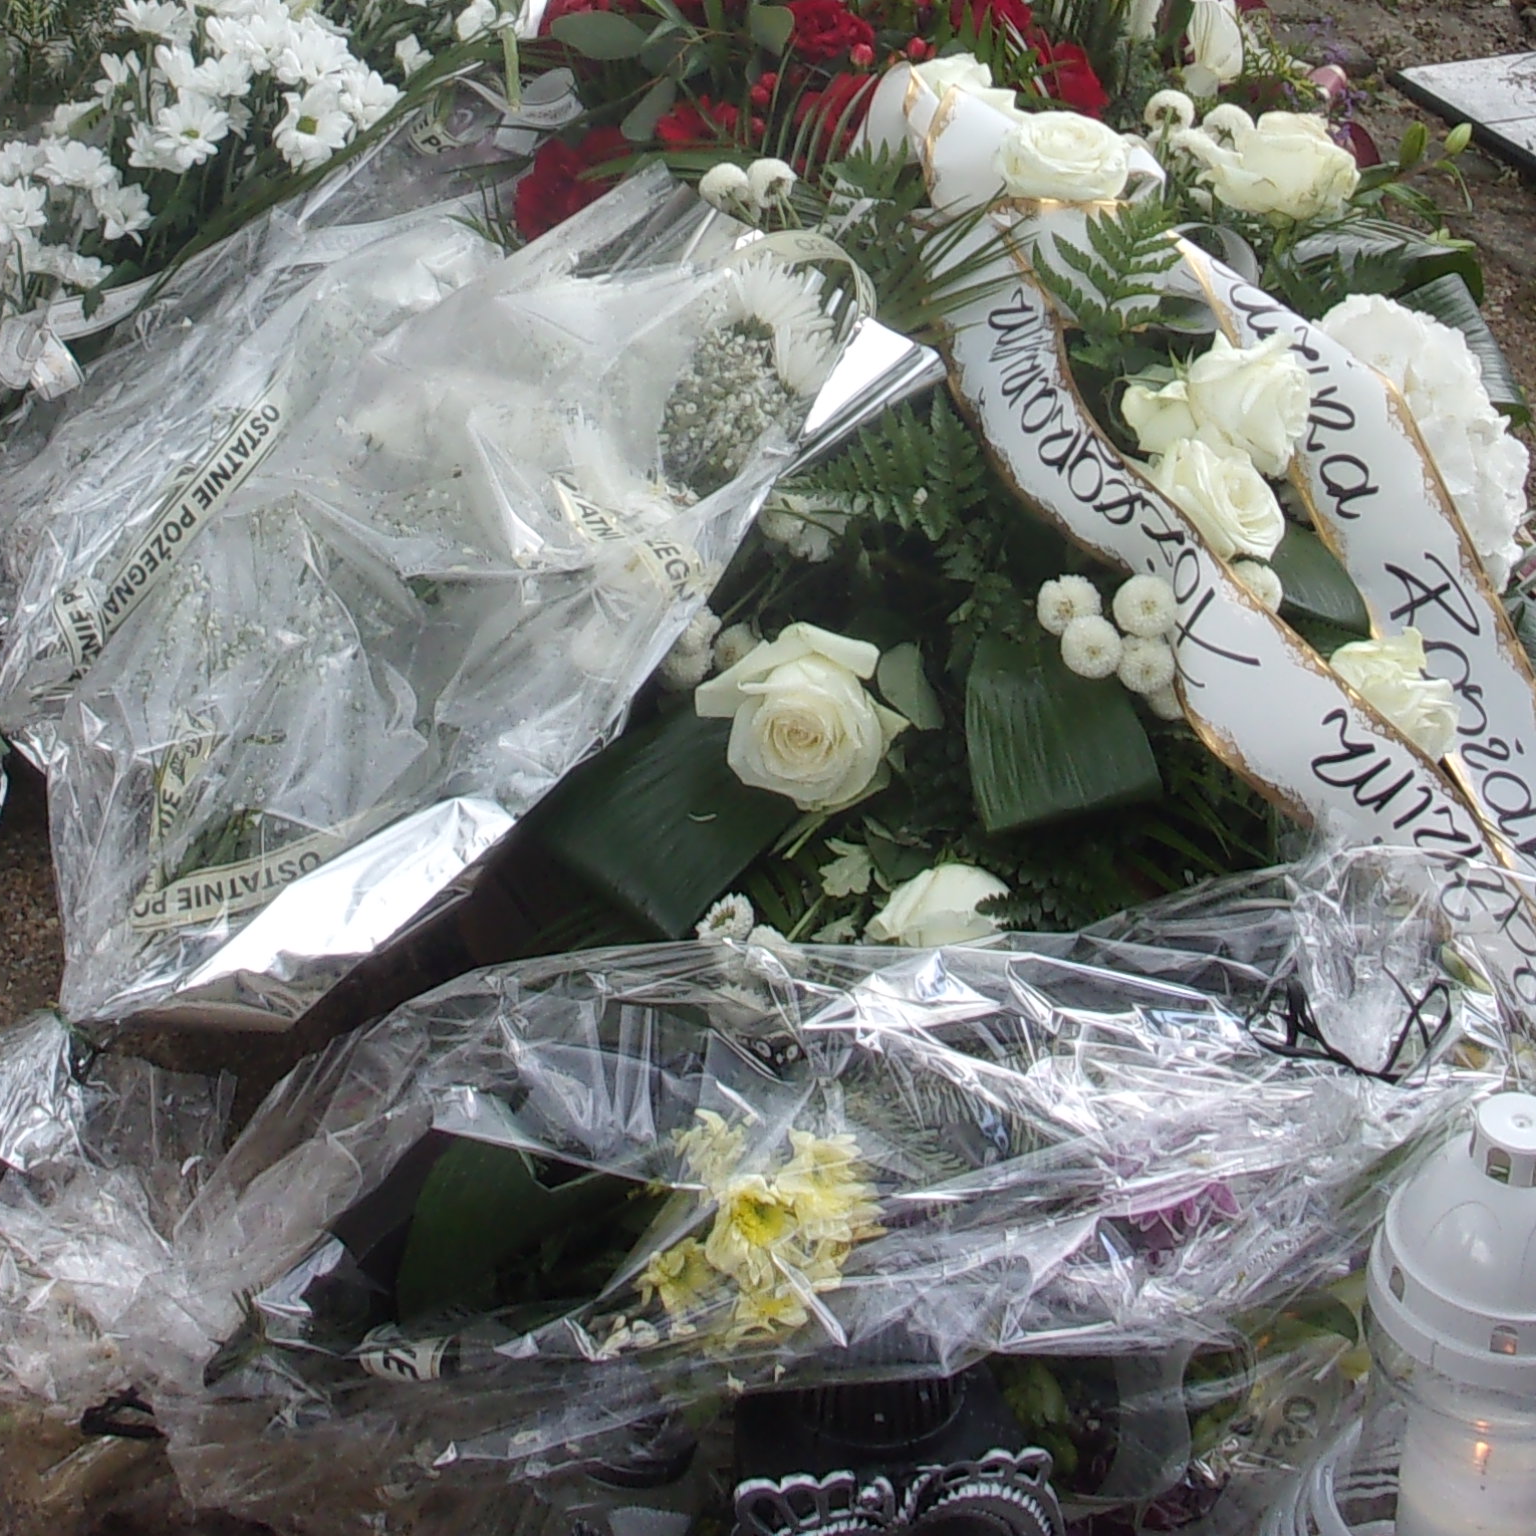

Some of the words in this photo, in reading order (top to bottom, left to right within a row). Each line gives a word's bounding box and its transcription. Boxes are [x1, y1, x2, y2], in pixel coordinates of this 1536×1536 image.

[190, 403, 282, 511] OSTATNIE
[102, 503, 197, 626] POŻEGNA
[177, 851, 321, 910] OSTATNIE
